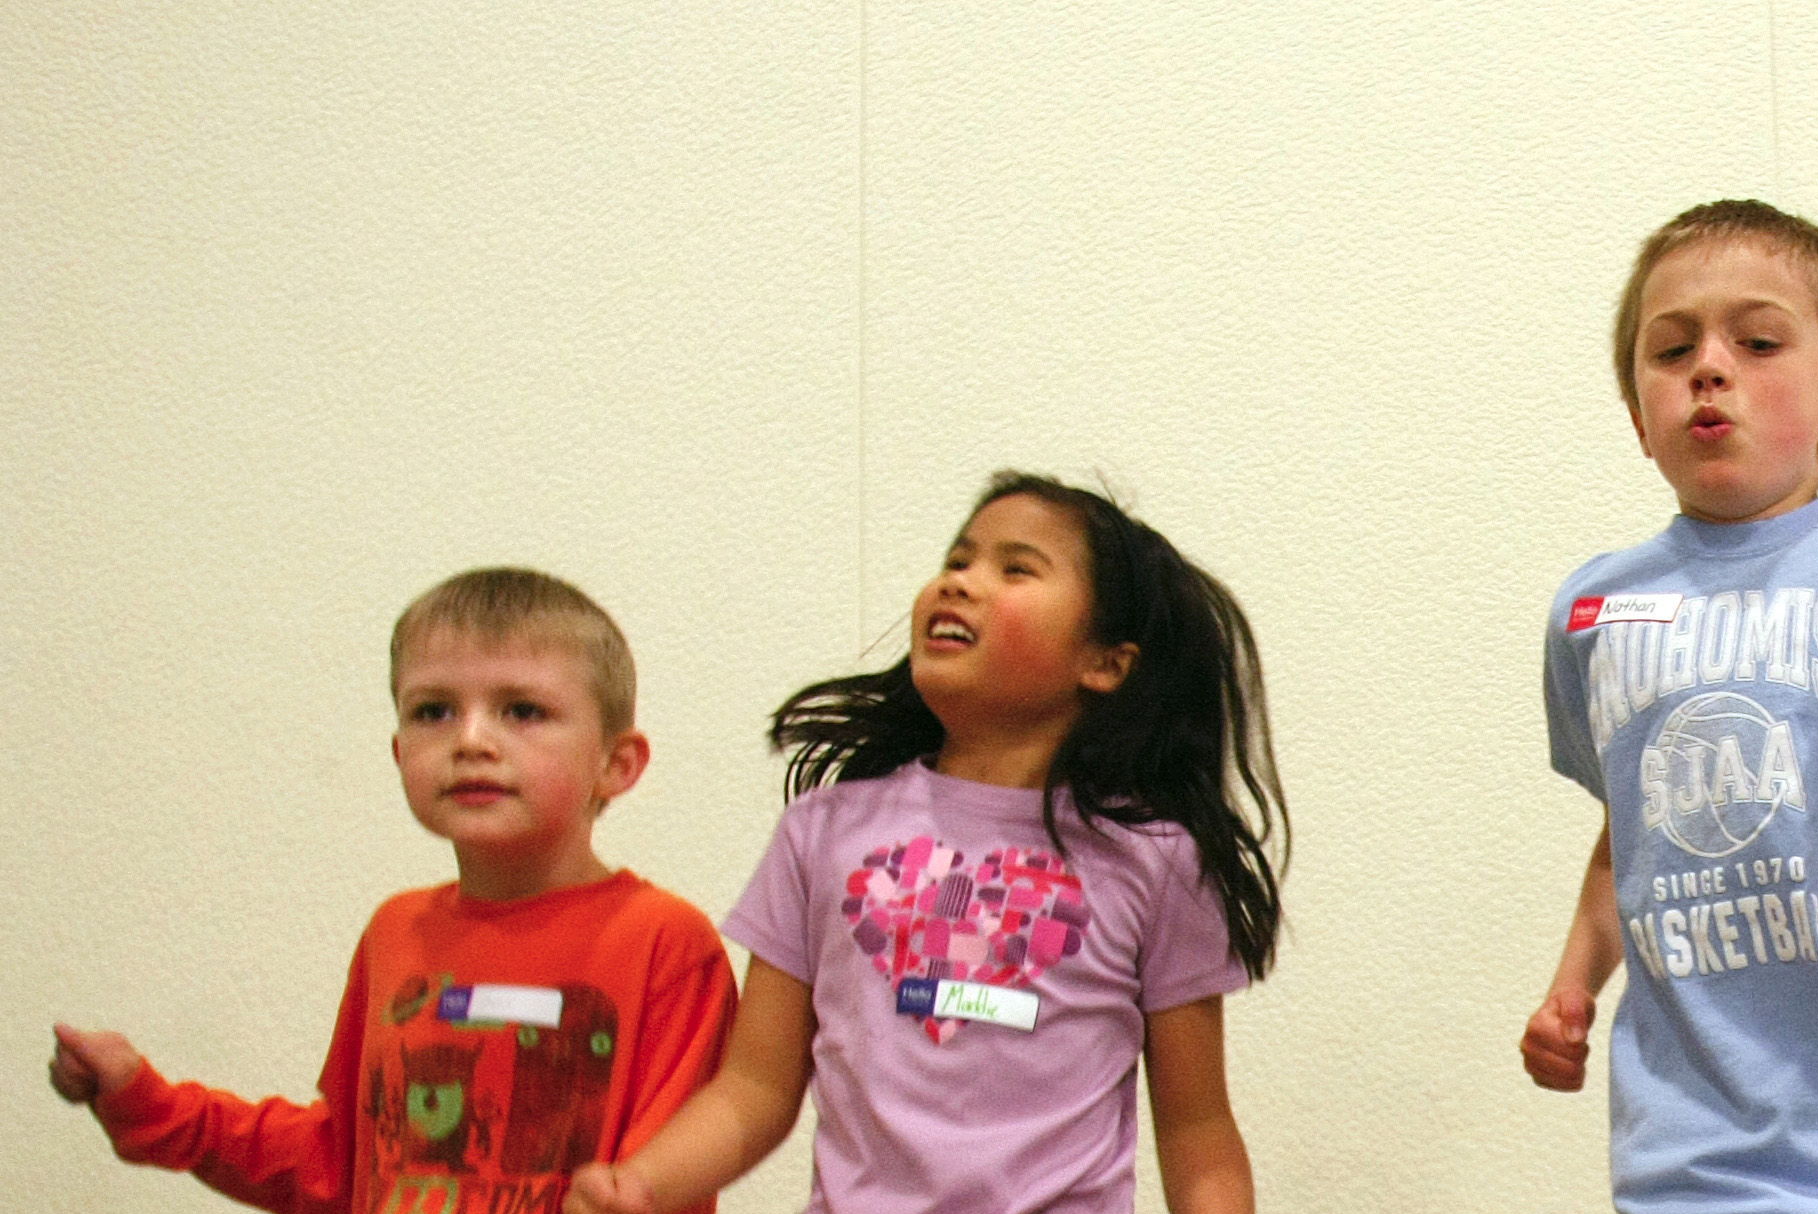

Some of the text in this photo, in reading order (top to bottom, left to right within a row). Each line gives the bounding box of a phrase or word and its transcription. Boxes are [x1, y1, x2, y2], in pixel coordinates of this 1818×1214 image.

[1603, 599, 1657, 616] Nathan
[1639, 719, 1806, 831] SJAA
[1653, 855, 1807, 902] SINCE 1970
